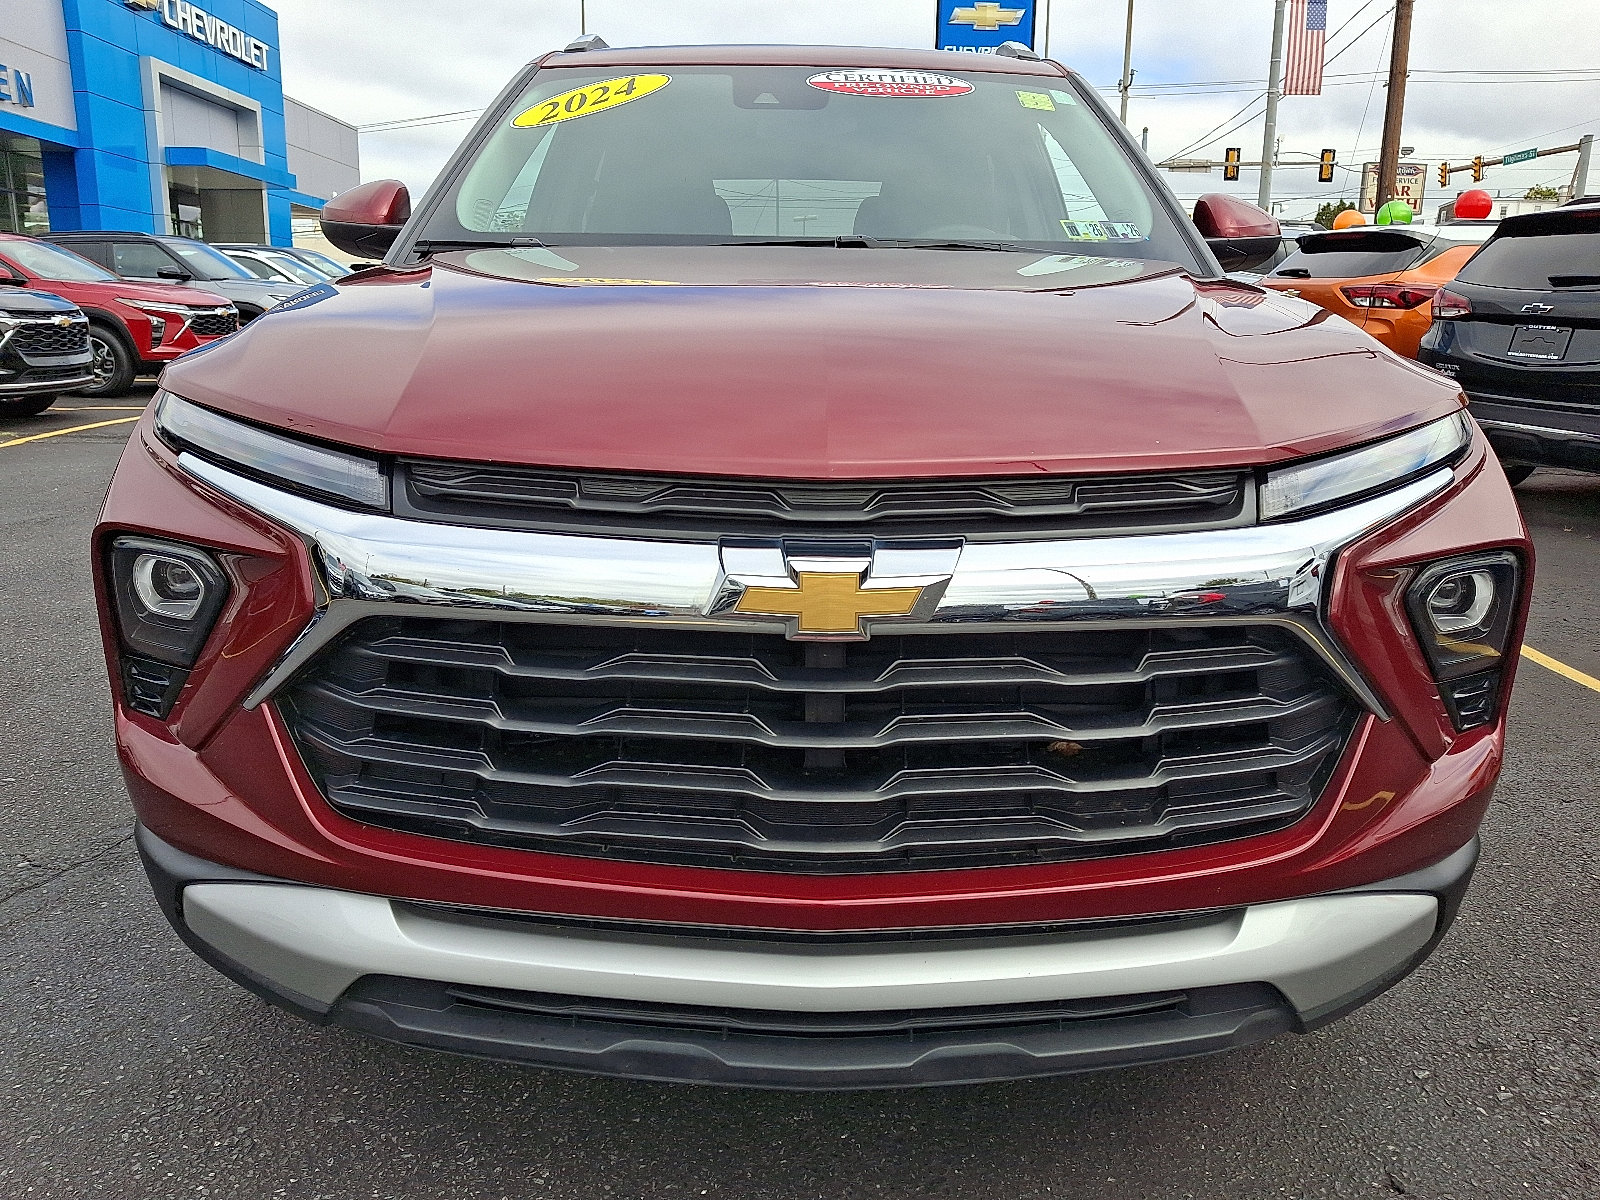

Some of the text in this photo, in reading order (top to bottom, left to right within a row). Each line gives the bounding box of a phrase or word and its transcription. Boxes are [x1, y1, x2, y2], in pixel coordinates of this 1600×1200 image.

[163, 0, 269, 71] CHEVROLET
[826, 73, 954, 85] CERTIFIED
[834, 82, 950, 92] PRE-OWNED
[853, 87, 936, 96] VEHICLE
[538, 77, 637, 124] 2024
